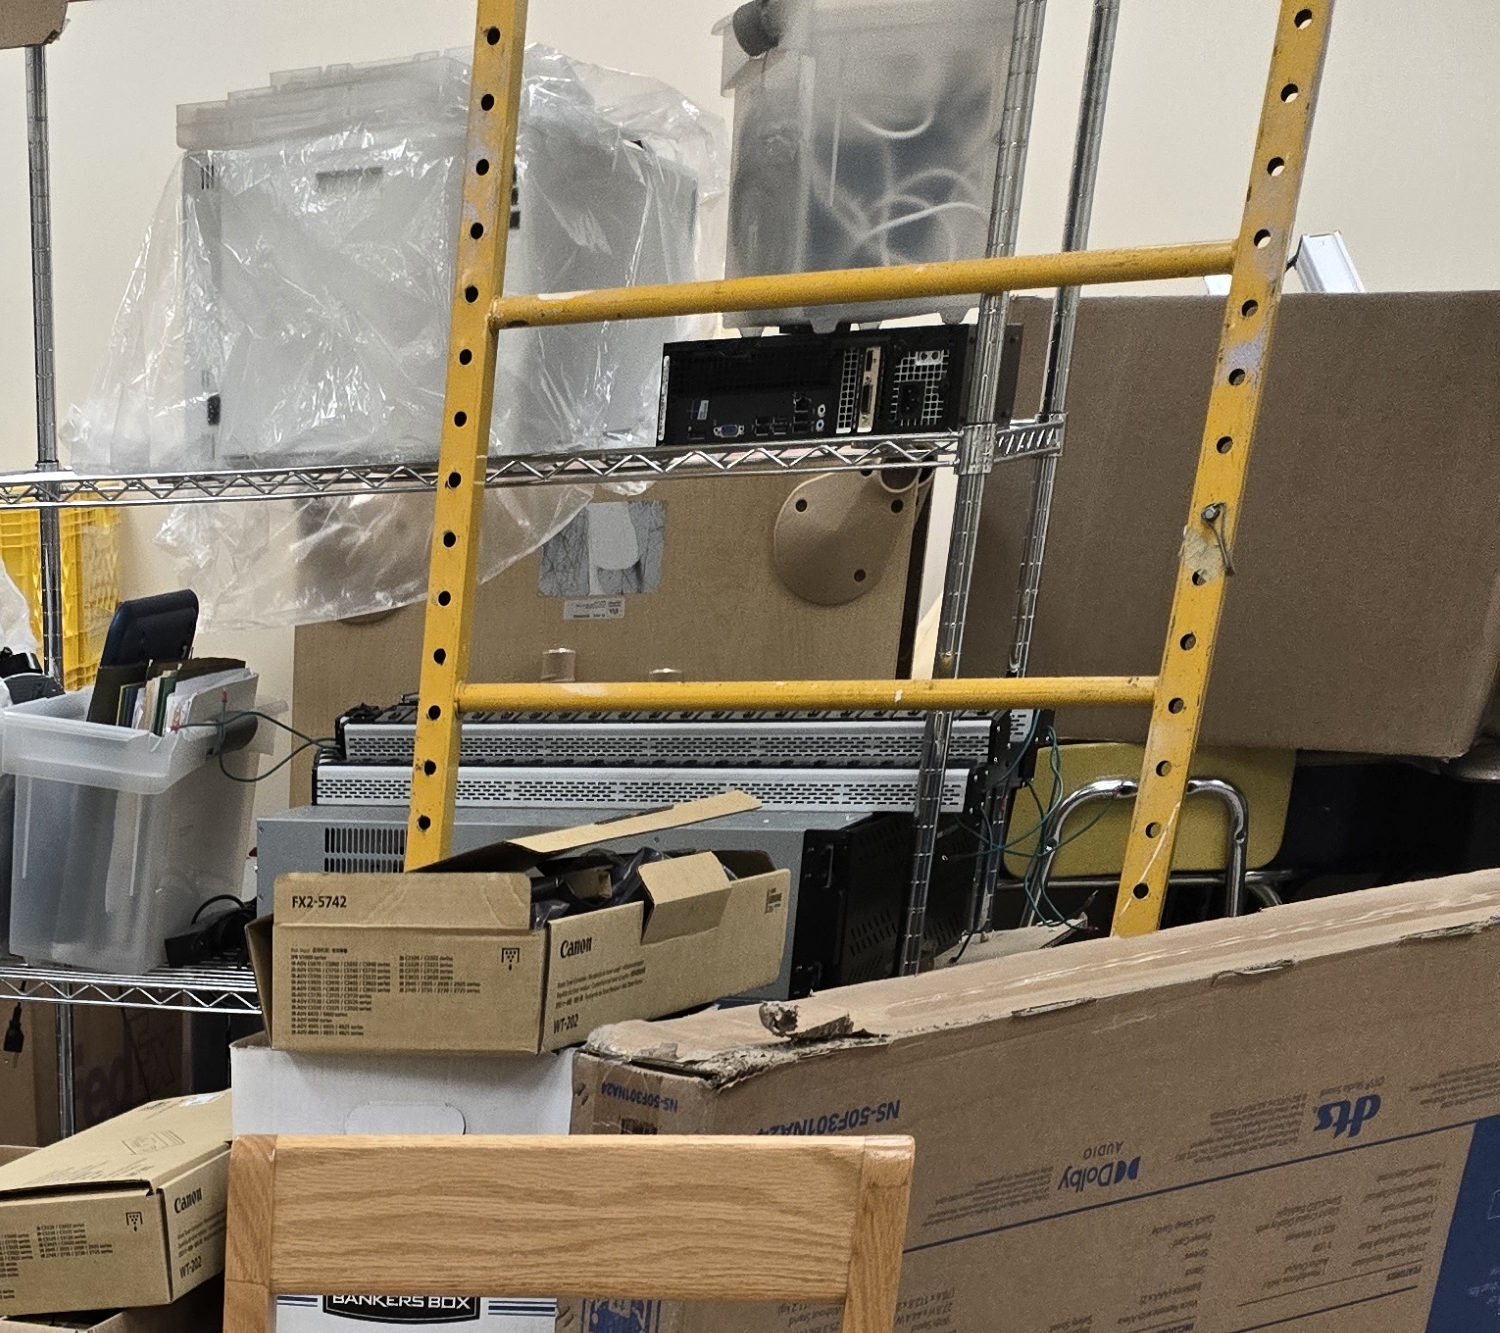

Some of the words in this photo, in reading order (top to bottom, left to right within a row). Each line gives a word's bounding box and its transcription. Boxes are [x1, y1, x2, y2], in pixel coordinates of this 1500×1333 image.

[291, 894, 348, 910] FX2-5742
[560, 934, 592, 959] Canon
[553, 1013, 578, 1034] WT-202
[1316, 1093, 1380, 1139] dts
[1082, 1140, 1124, 1161] AUDIO
[1058, 1159, 1113, 1192] Dolby
[174, 1186, 202, 1214] Canon
[179, 1254, 202, 1279] WT-202
[332, 1295, 425, 1308] BANKERS
[428, 1296, 472, 1310] BOX
